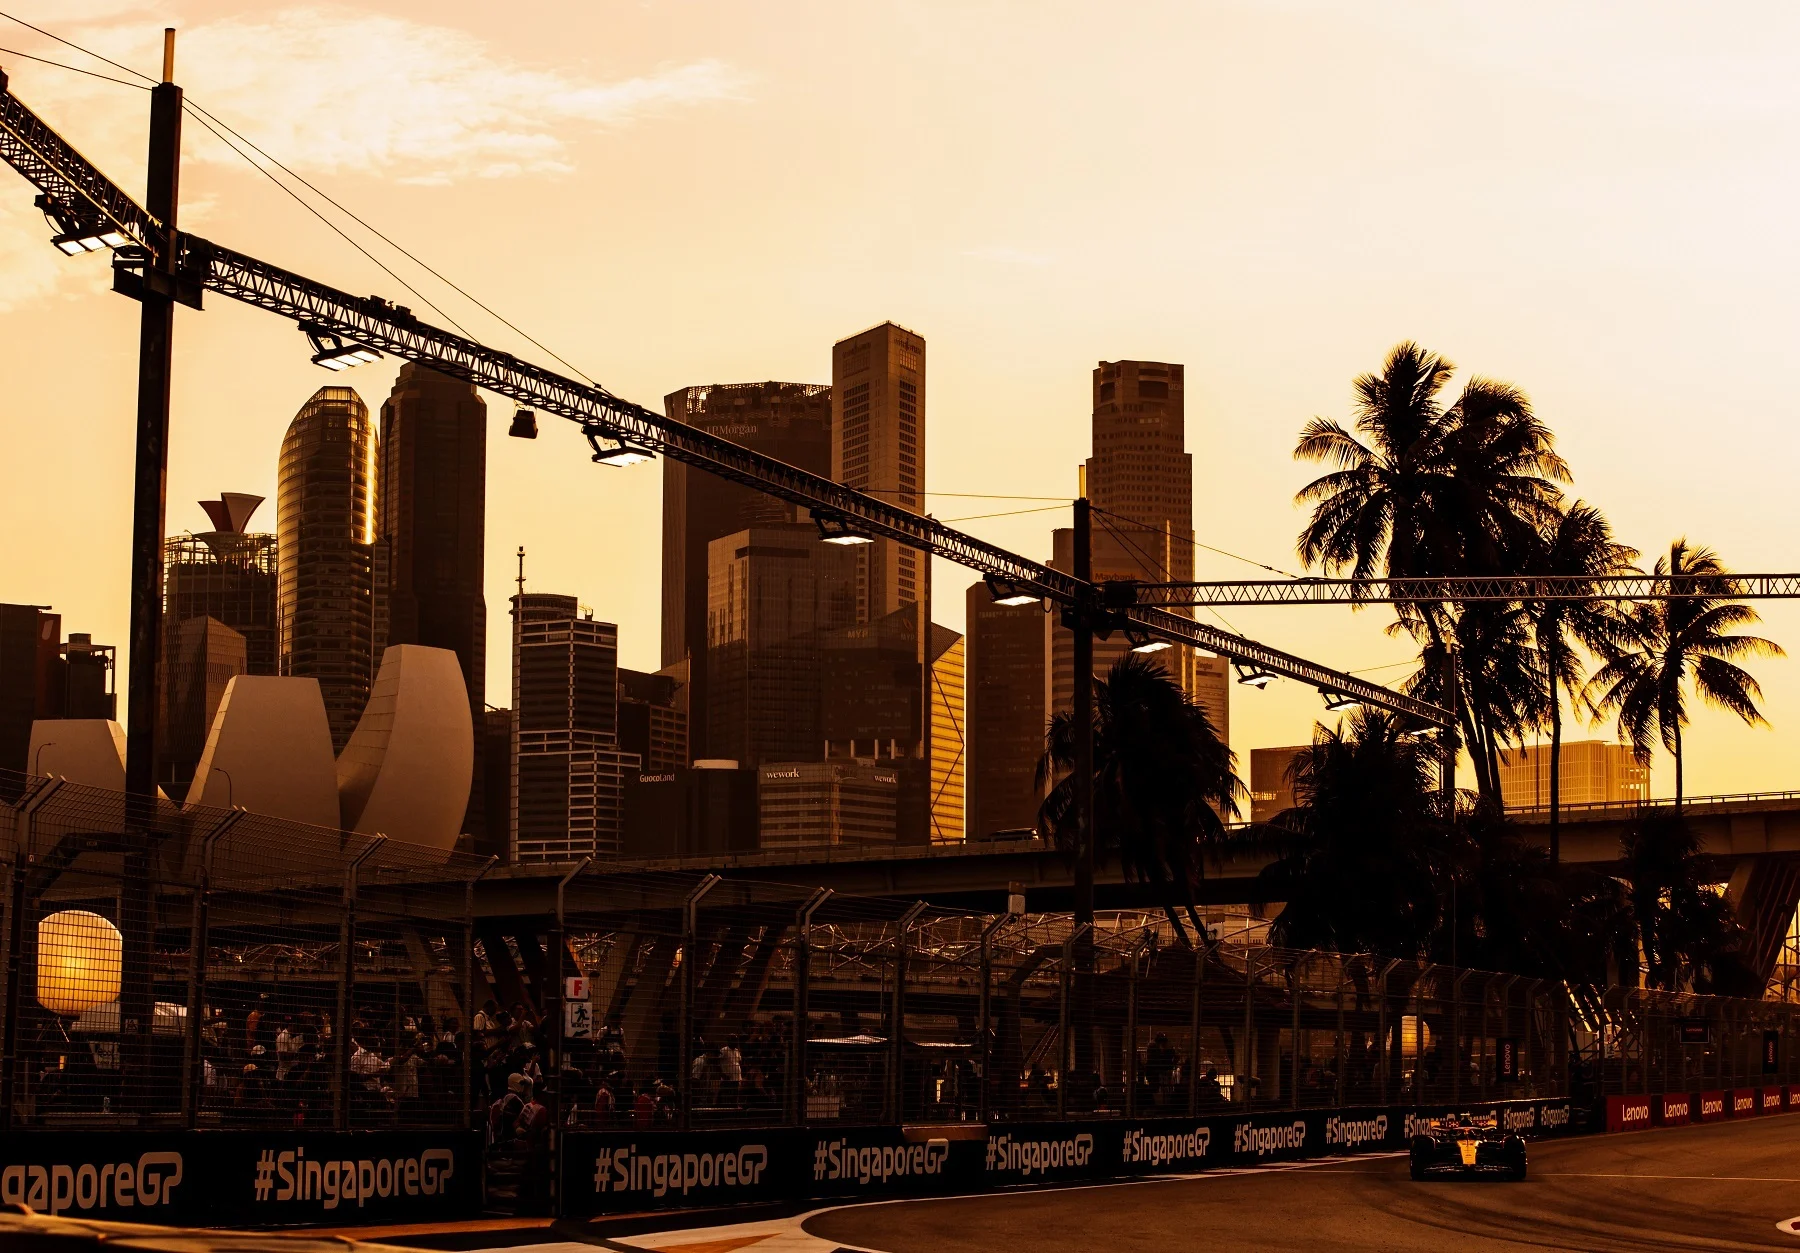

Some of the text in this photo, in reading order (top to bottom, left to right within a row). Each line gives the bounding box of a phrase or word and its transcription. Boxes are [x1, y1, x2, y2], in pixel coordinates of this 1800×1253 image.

[1094, 572, 1136, 582] Maybank
[847, 629, 869, 639] MYP
[639, 773, 675, 783] GuocoLand
[766, 768, 800, 779] wework
[874, 773, 897, 784] wework
[573, 980, 583, 996] F
[1503, 1043, 1511, 1074] Lenovo
[1664, 1101, 1688, 1118] Lenovo
[1701, 1099, 1723, 1115] Lenovo
[1734, 1096, 1753, 1111] Lenovo
[1763, 1093, 1781, 1108] Lenovo
[1503, 1106, 1535, 1132] #SingaporeGP
[1540, 1104, 1570, 1128] #SingaporeGP
[1622, 1104, 1649, 1122] Lenovo
[1234, 1120, 1306, 1155] #SingaporeGP
[1325, 1115, 1388, 1147] #SingaporeGP
[985, 1133, 1094, 1176] #SingaporeGP
[1122, 1126, 1211, 1166] #SingaporeGP
[813, 1137, 950, 1185] #SingaporeGP
[254, 1147, 455, 1210] #SingaporeGP
[594, 1144, 768, 1198] #SingaporeGP
